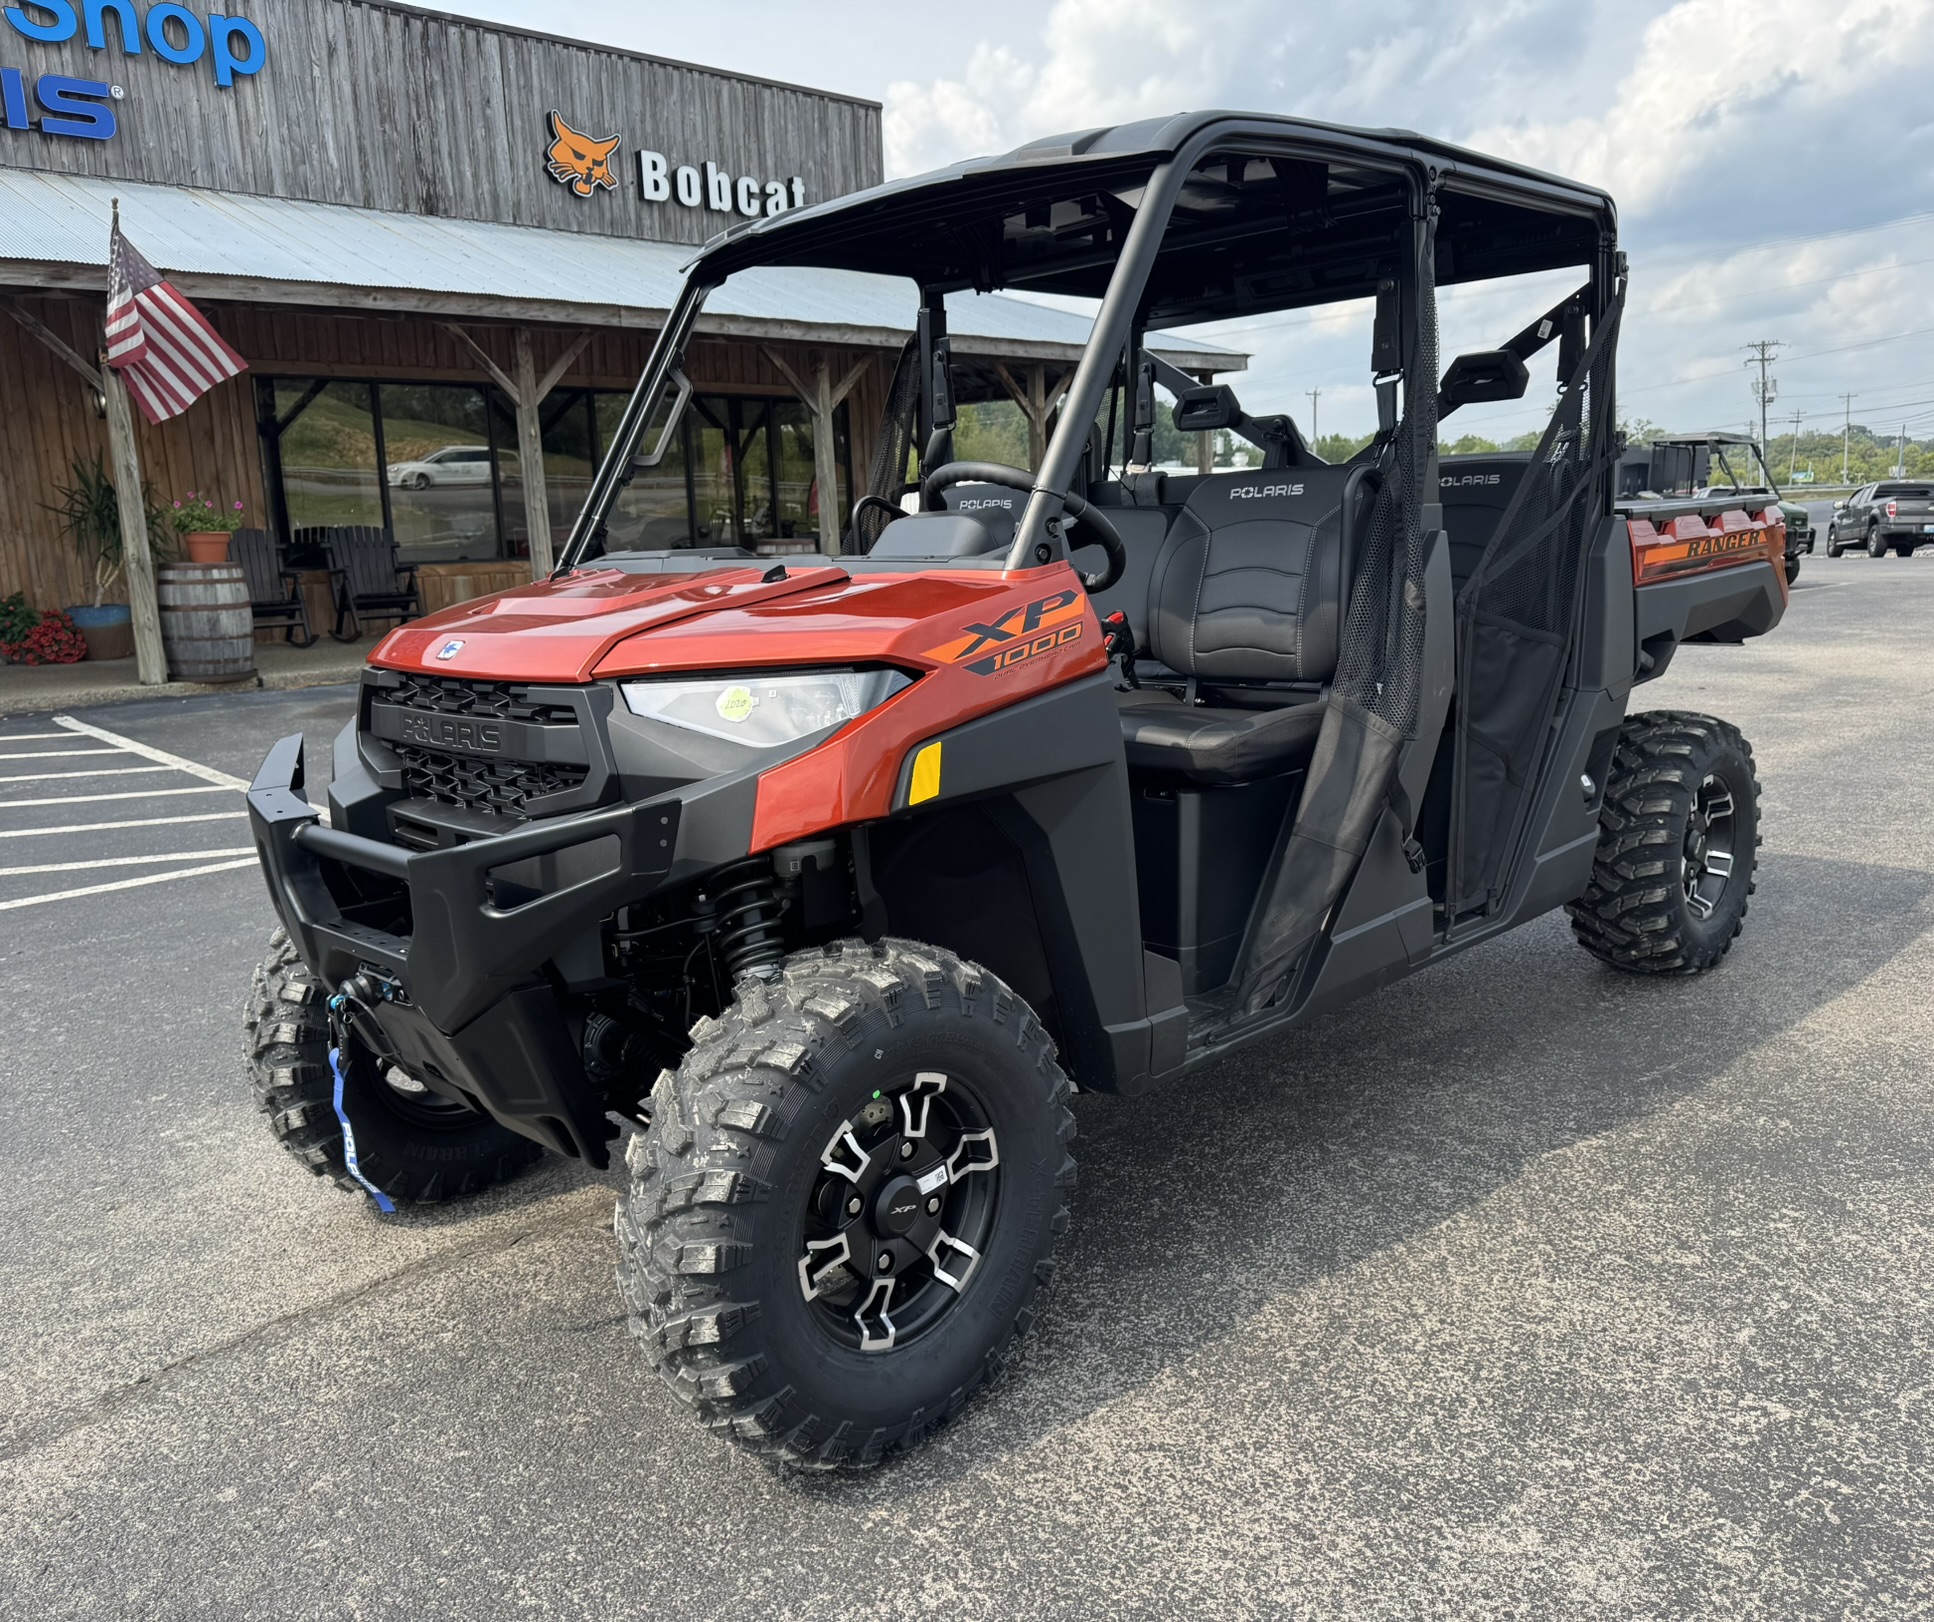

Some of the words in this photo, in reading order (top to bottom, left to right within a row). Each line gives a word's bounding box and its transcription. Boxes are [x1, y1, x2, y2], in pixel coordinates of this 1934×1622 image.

[638, 149, 806, 218] Bobcat
[1229, 483, 1305, 500] POLARIS
[1439, 474, 1501, 488] OLARIS
[1686, 530, 1761, 558] RANGER
[953, 589, 1079, 660] XP
[992, 622, 1083, 671] 1000
[402, 714, 501, 753] POLARIS
[890, 1203, 918, 1215] XP
